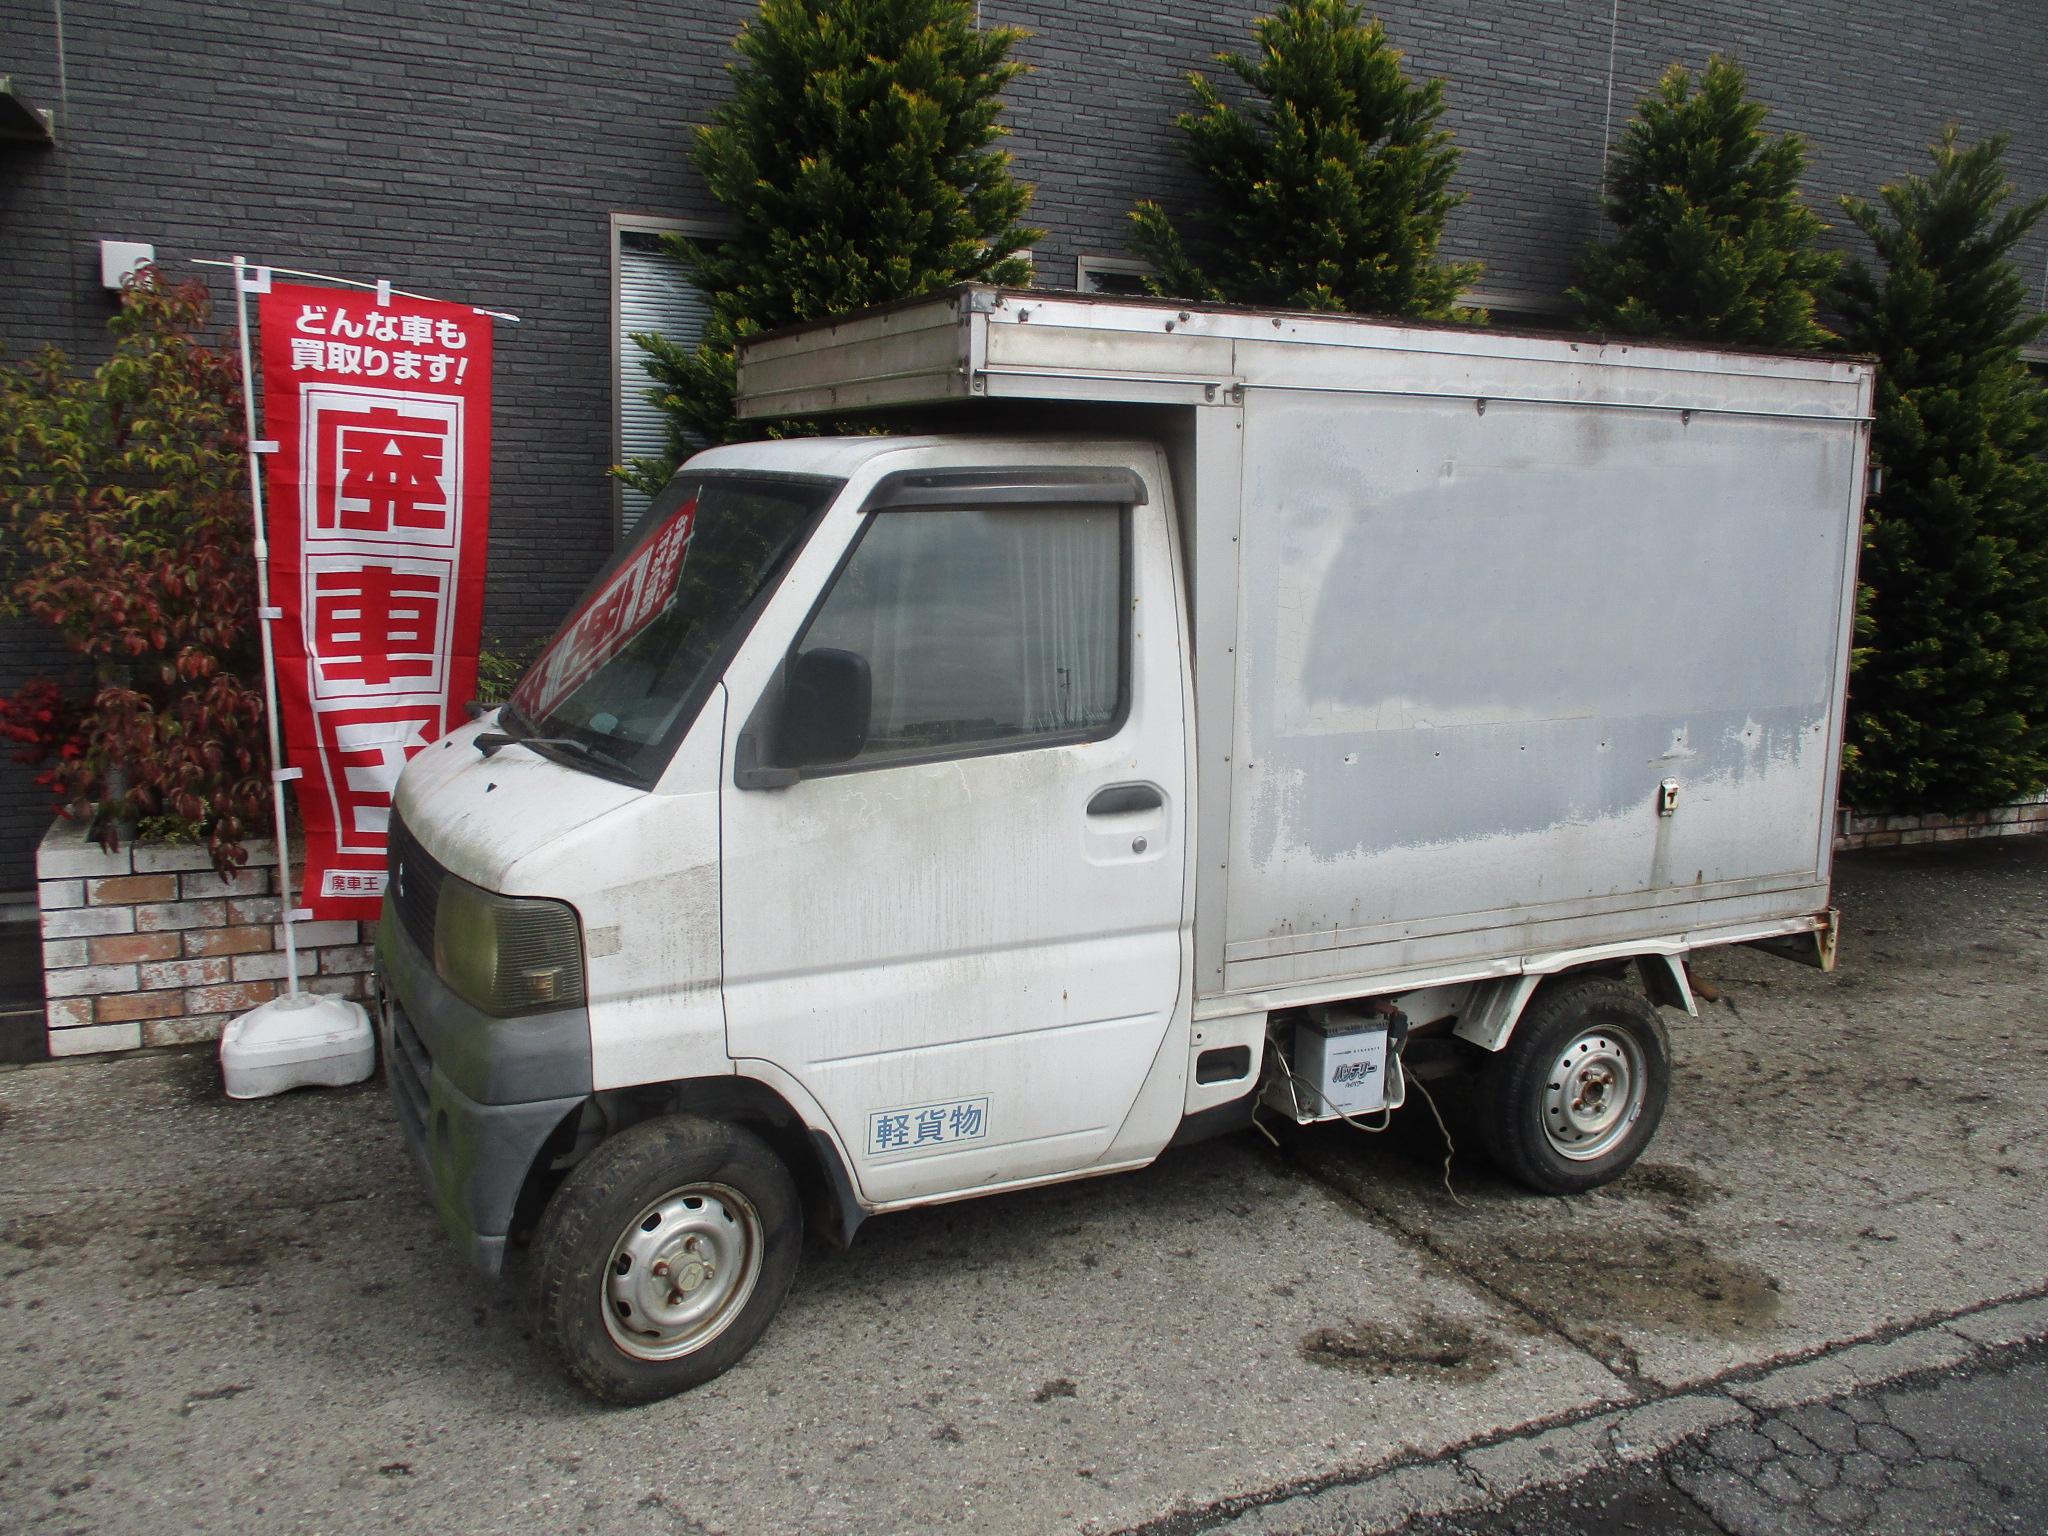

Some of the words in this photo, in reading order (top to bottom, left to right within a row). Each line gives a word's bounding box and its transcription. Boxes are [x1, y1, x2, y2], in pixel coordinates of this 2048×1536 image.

[295, 304, 466, 349] どんな車も
[290, 337, 468, 385] 買取ります!
[331, 875, 379, 891] 廃車王
[1332, 1060, 1378, 1084] バッテリー
[875, 1104, 982, 1149] 軽貨物
